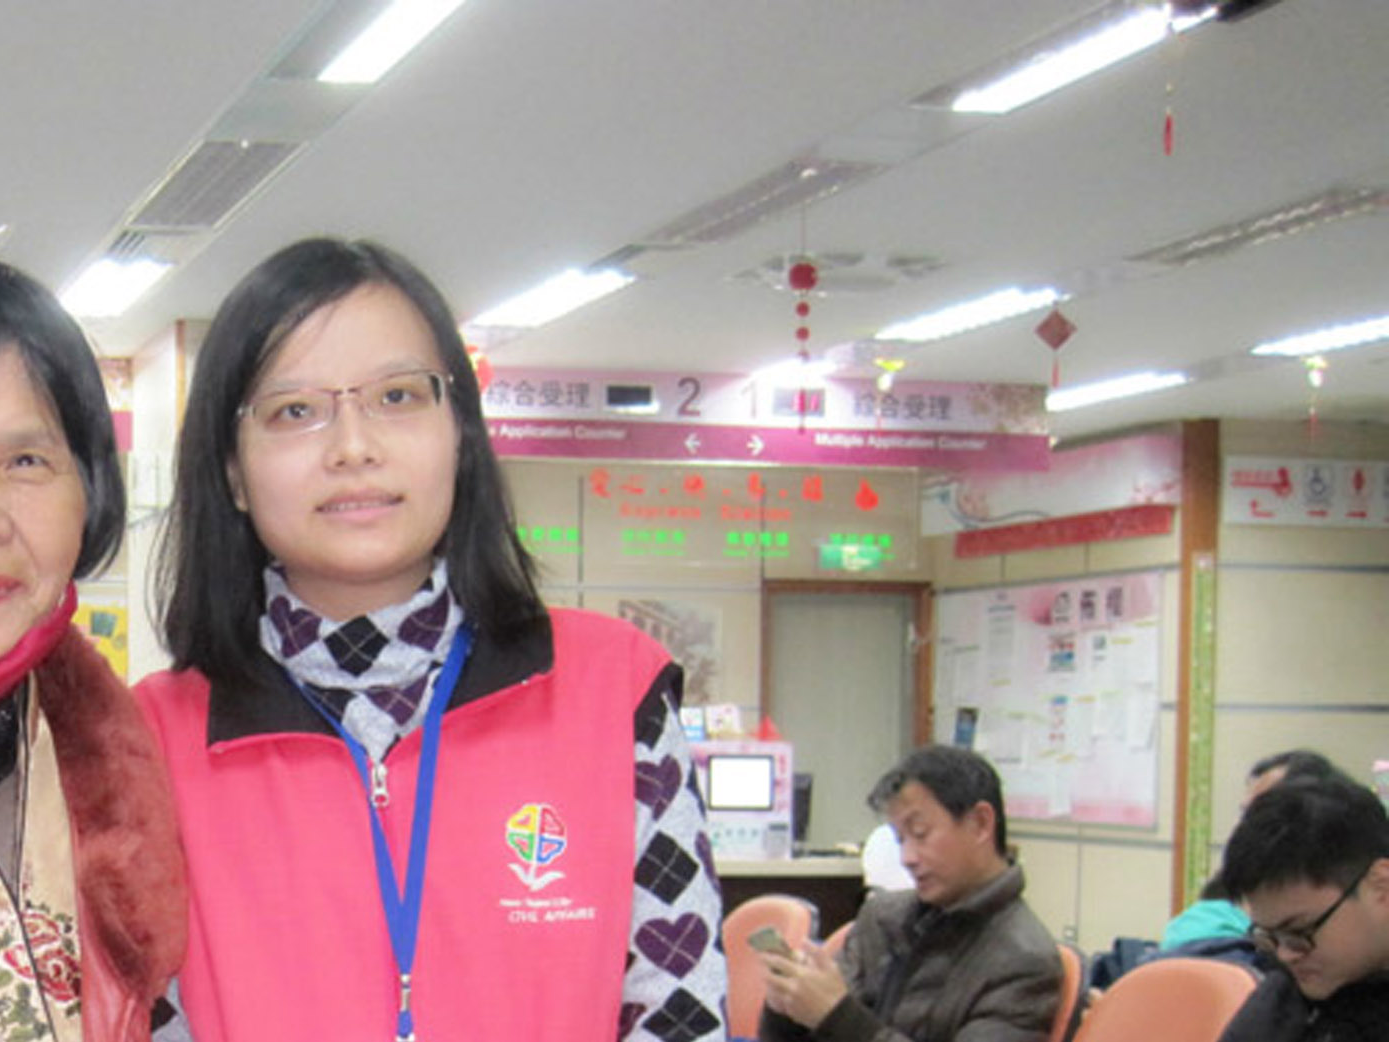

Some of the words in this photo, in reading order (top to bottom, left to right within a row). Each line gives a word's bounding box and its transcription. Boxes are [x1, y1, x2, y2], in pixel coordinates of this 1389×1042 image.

[677, 376, 701, 417] 2
[741, 381, 757, 419] 1
[499, 424, 572, 440] Application
[574, 424, 627, 440] Counter
[815, 431, 864, 448] Multiple
[868, 433, 935, 450] Application
[938, 435, 986, 450] Counter
